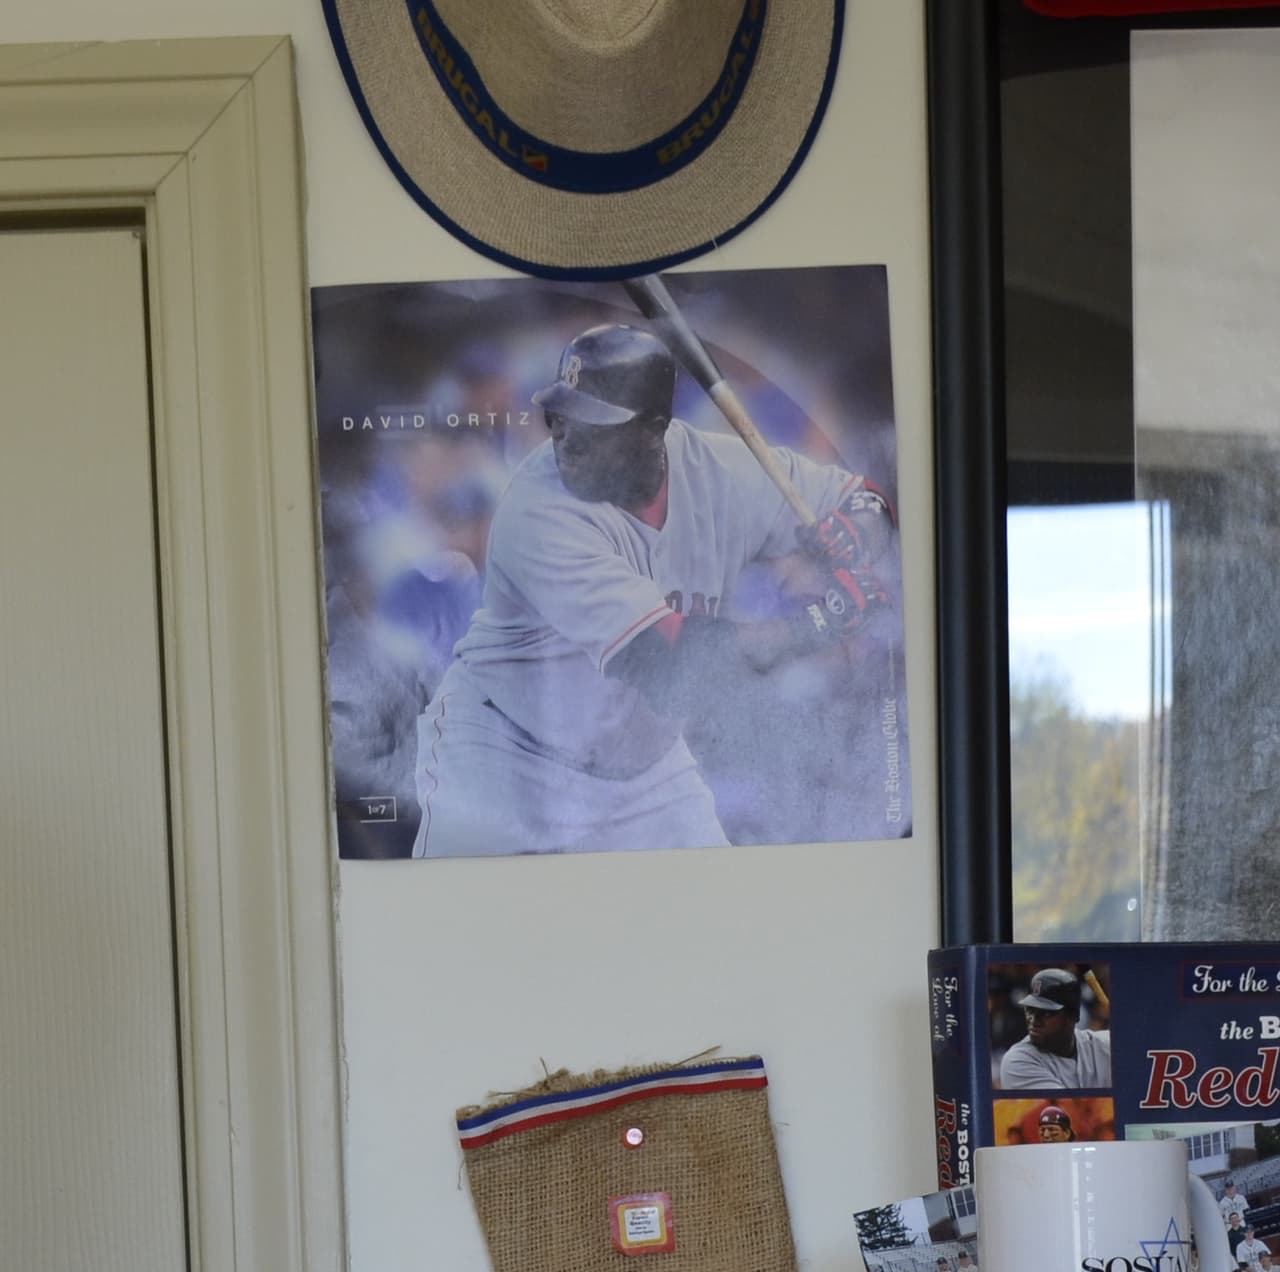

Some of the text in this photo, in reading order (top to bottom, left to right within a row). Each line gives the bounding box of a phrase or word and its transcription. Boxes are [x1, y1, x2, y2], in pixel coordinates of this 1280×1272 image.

[342, 412, 531, 431] DAVID ORTIZ
[1192, 965, 1233, 994] For
[1239, 967, 1269, 992] the
[1220, 1021, 1255, 1041] the
[1140, 1046, 1280, 1109] Red
